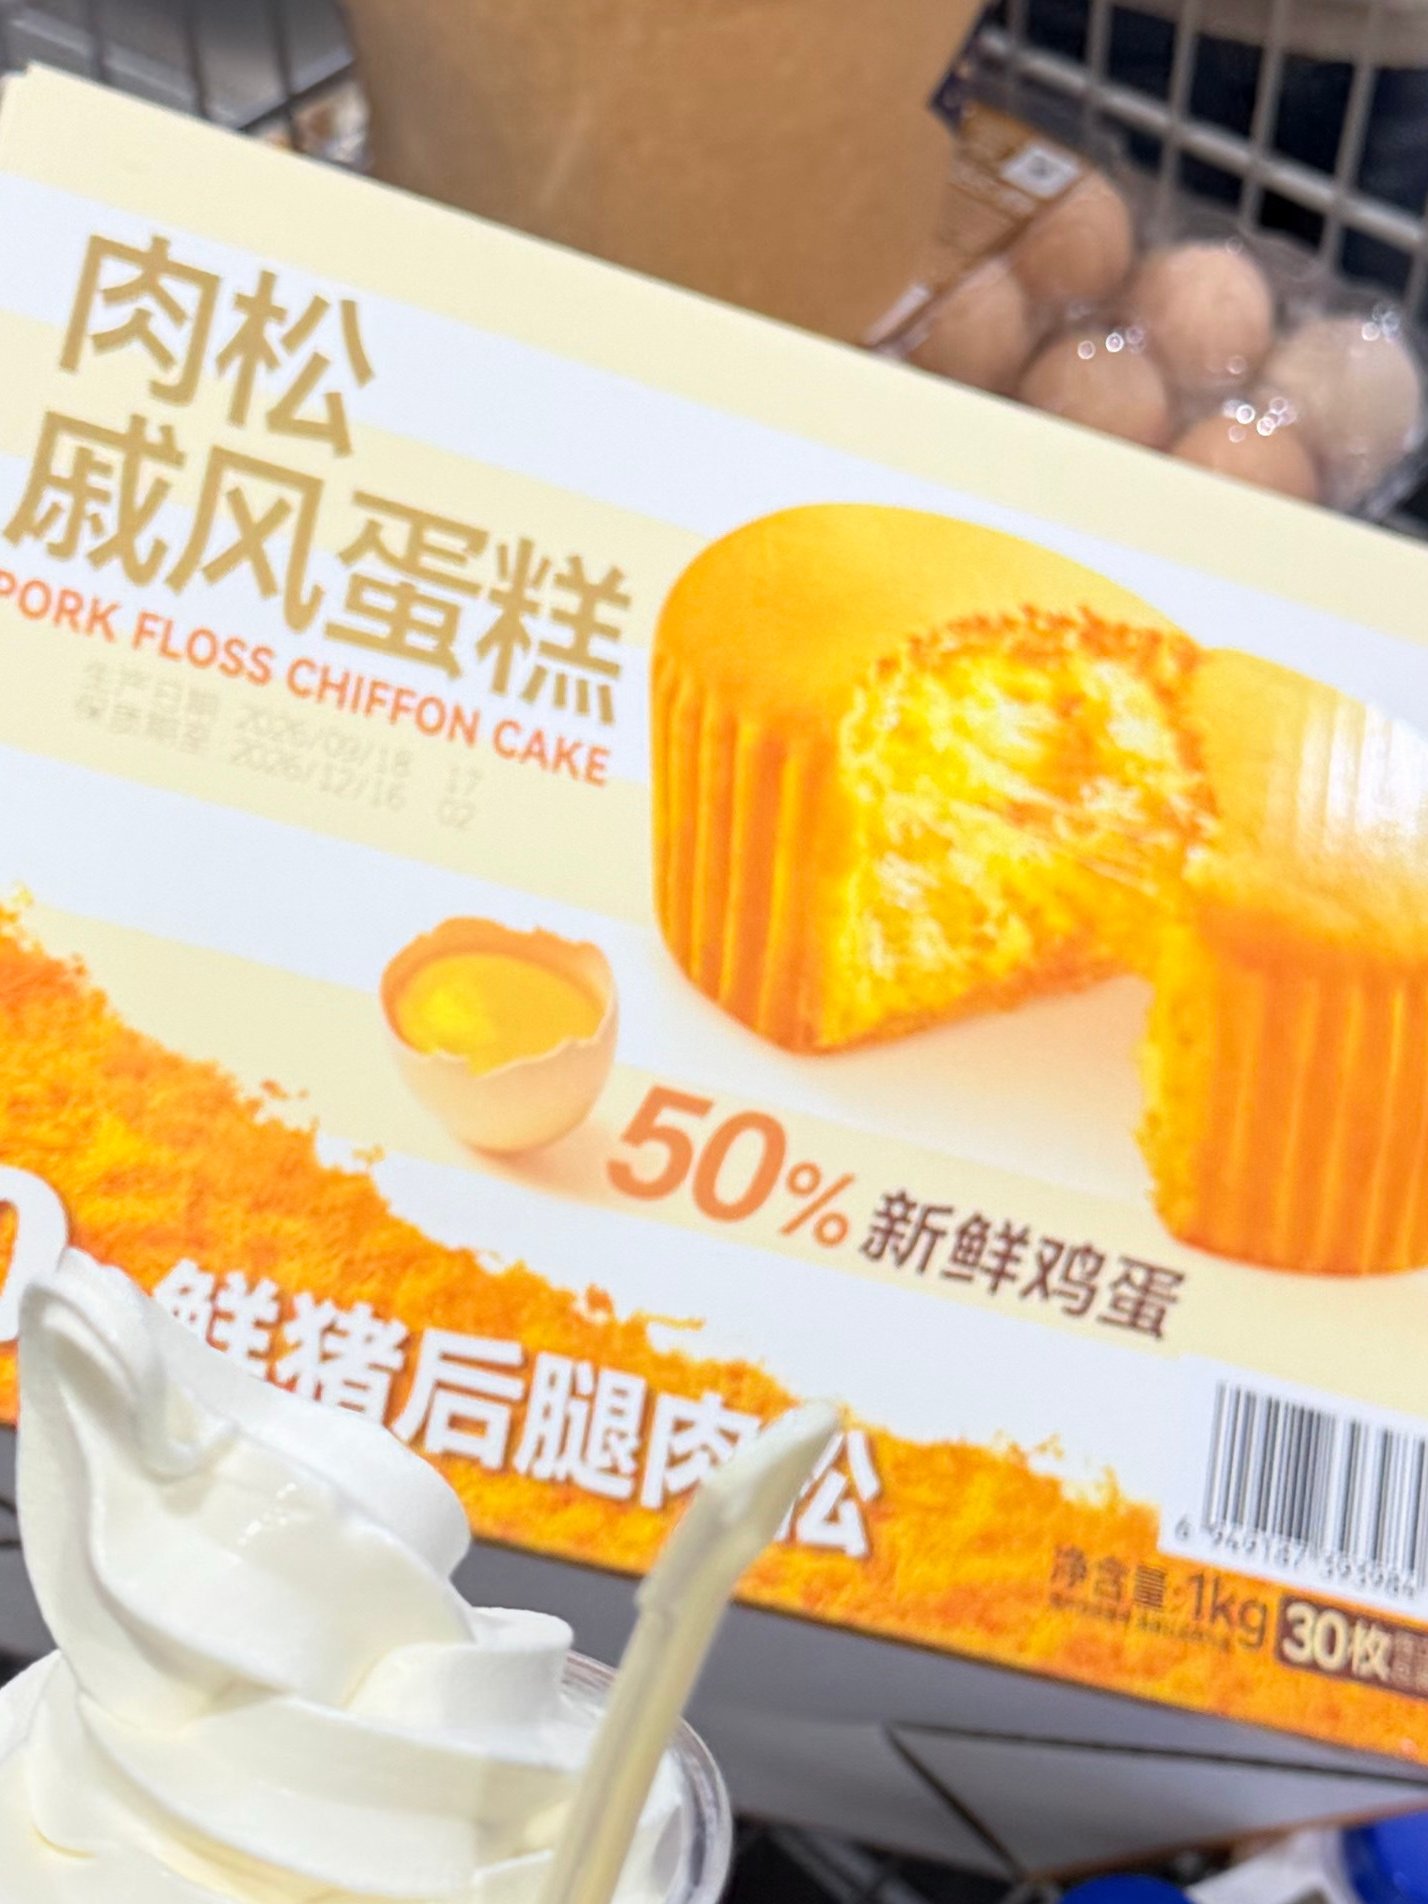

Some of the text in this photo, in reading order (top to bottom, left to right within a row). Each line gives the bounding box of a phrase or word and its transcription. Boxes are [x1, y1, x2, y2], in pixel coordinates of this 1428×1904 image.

[60, 234, 376, 457] 肉松
[2, 409, 634, 726] 戚风蛋糕
[132, 611, 273, 688] FLOSS
[287, 658, 479, 749] CHIFFON
[494, 719, 612, 787] CAKE
[606, 1085, 1187, 1342] 50% 新鲜鸡蛋
